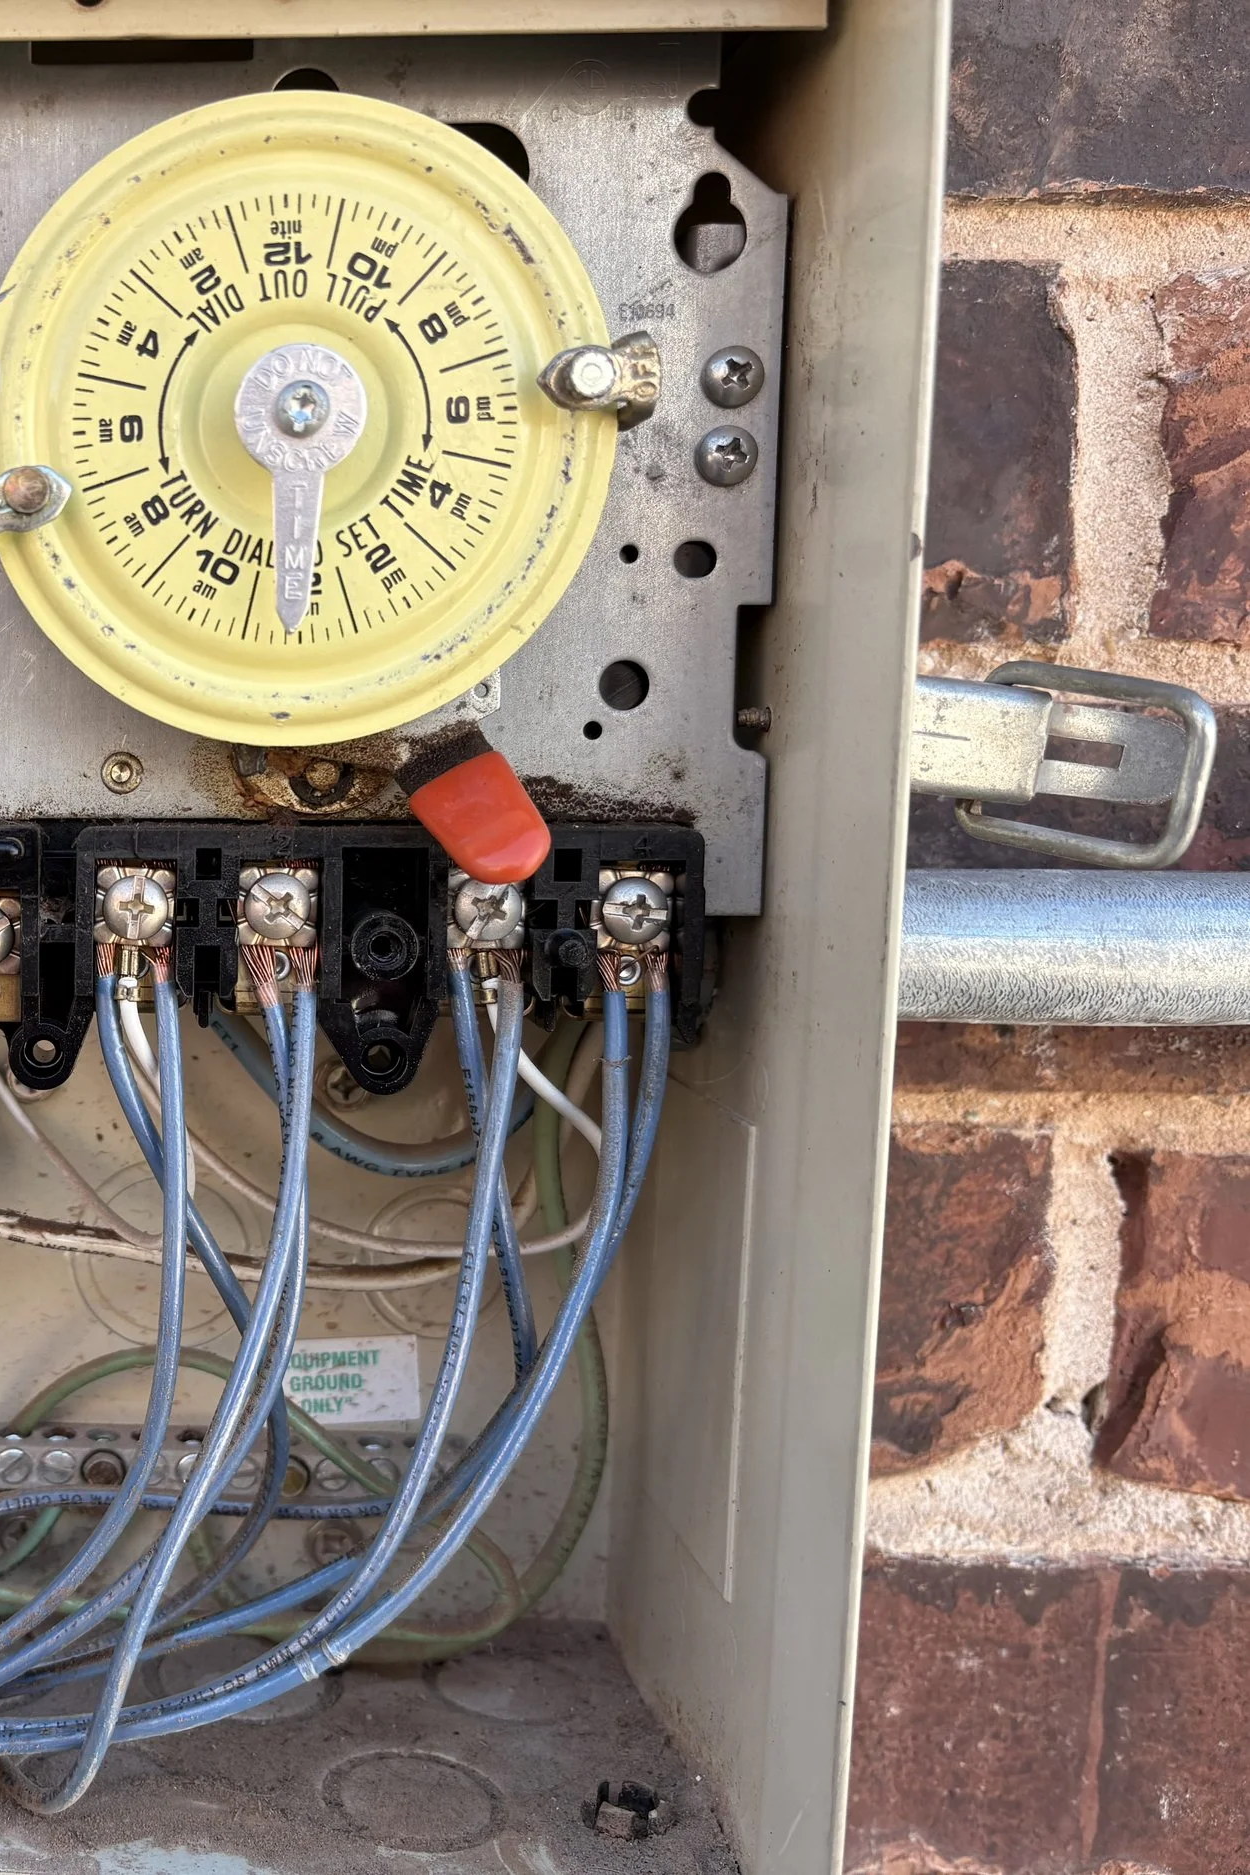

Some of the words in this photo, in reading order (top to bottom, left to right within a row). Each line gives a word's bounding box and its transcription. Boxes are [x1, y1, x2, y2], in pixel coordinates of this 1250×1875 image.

[270, 220, 302, 239] nite
[180, 248, 205, 269] am
[264, 241, 312, 266] 12
[347, 252, 391, 288] 10
[370, 237, 399, 258] pm
[190, 265, 222, 295] 2
[259, 269, 308, 302] OUT
[186, 284, 244, 333] DIAL
[327, 272, 388, 323] PULL
[116, 321, 137, 346] am
[418, 313, 447, 344] 8
[444, 301, 470, 327] pm
[136, 330, 159, 359] 4
[446, 396, 470, 424] 6
[476, 396, 495, 421] pm
[99, 418, 113, 443] am
[120, 415, 143, 442] 6
[141, 495, 169, 526] 8
[336, 514, 380, 558] SET
[380, 455, 435, 518] TIME
[429, 480, 453, 509] 4
[450, 493, 472, 521] pm
[123, 513, 145, 537] am
[160, 470, 219, 539] TURN
[222, 528, 274, 568] DIAL
[284, 481, 308, 600] TIME
[196, 550, 240, 586] 10
[365, 543, 397, 575] 2
[381, 566, 407, 594] pm
[192, 580, 217, 600] am
[330, 1147, 379, 1172] AWG
[289, 1350, 380, 1369] QUIPMENT
[290, 1373, 363, 1392] GROUND
